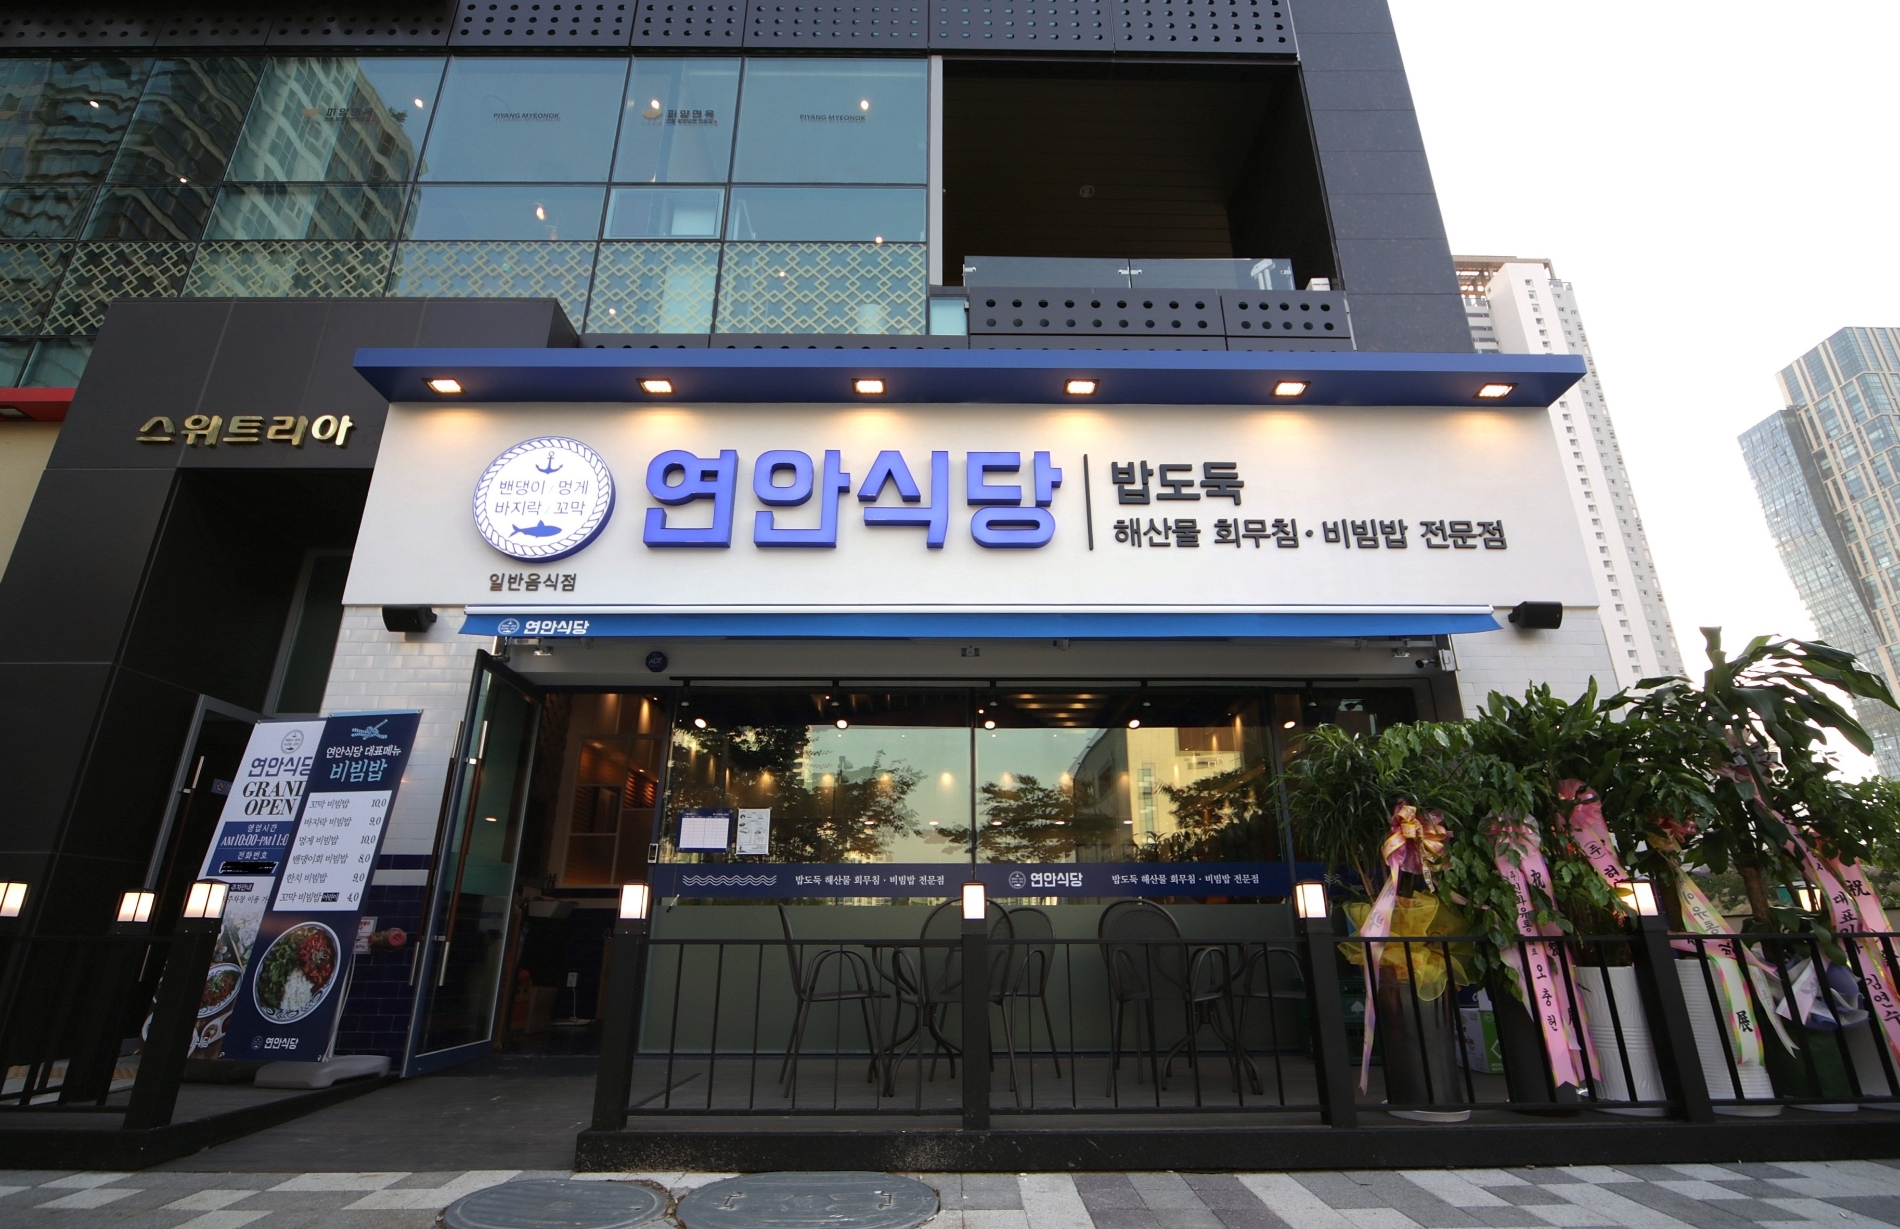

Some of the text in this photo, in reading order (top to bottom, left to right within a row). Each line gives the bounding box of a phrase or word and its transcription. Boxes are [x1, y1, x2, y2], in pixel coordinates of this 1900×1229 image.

[135, 414, 354, 446] 스위트리아
[499, 479, 589, 496] 밴댕이 멍게
[1110, 460, 1245, 506] 밥도둑
[643, 449, 1063, 549] 연안식당
[495, 500, 586, 517] 바지락 꼬막
[1113, 517, 1201, 549] 해산물
[1420, 518, 1509, 550] 전문점
[489, 572, 577, 592] 일반음식점
[523, 620, 590, 635] 연안식당
[326, 744, 402, 758] 연안식당 대표메뉴
[329, 759, 388, 782] 비빔밥
[244, 798, 298, 816] OPEN
[309, 799, 326, 809] 꼬막
[327, 798, 350, 809] 비빔밥
[247, 823, 278, 833] 영업시간
[304, 817, 327, 827] 바지락
[329, 816, 352, 827] 비빔밥
[299, 835, 314, 846] 멍게
[315, 835, 339, 846] 비빔밥
[237, 850, 268, 860] 전화번호
[325, 853, 349, 864] 비빔밥
[287, 872, 303, 883] 한치
[304, 872, 328, 884] 비빔밥
[795, 874, 822, 886] 밥도둑
[824, 874, 851, 886] 해산물
[918, 874, 945, 886] 전문점
[1030, 872, 1083, 888] 연안식당
[1111, 873, 1138, 885] 밥도둑
[1140, 873, 1167, 885] 해산물
[1233, 873, 1260, 885] 전문점
[1845, 879, 1872, 897] 祝
[279, 893, 297, 903] 꼬막
[298, 892, 321, 903] 비빔밥
[1735, 1009, 1754, 1033] 展
[264, 1037, 299, 1050] 연안식당
